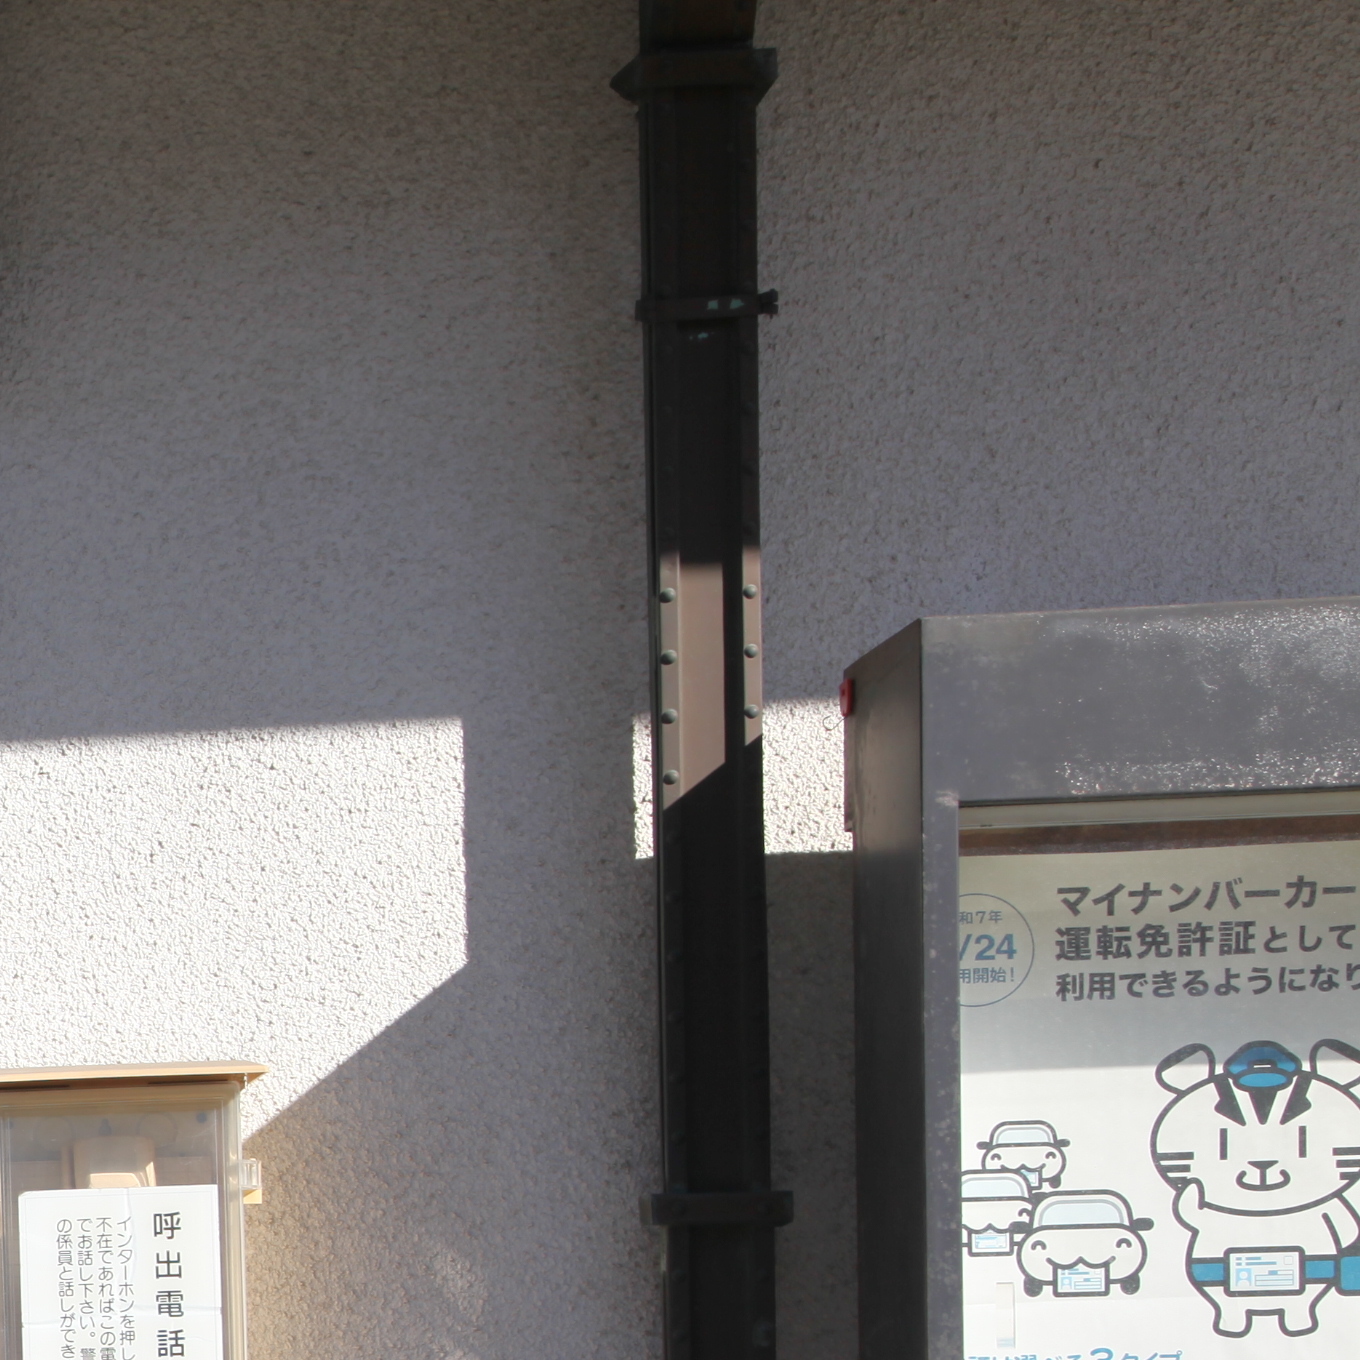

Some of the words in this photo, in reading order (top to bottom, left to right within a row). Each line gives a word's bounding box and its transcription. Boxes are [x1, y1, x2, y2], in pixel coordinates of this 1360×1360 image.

[1056, 876, 1357, 917] マイナンバーカー
[1055, 920, 1355, 961] 運転免許証として
[1056, 965, 1360, 1003] 利用できるようになり
[77, 1218, 96, 1339] でお話し下さい。
